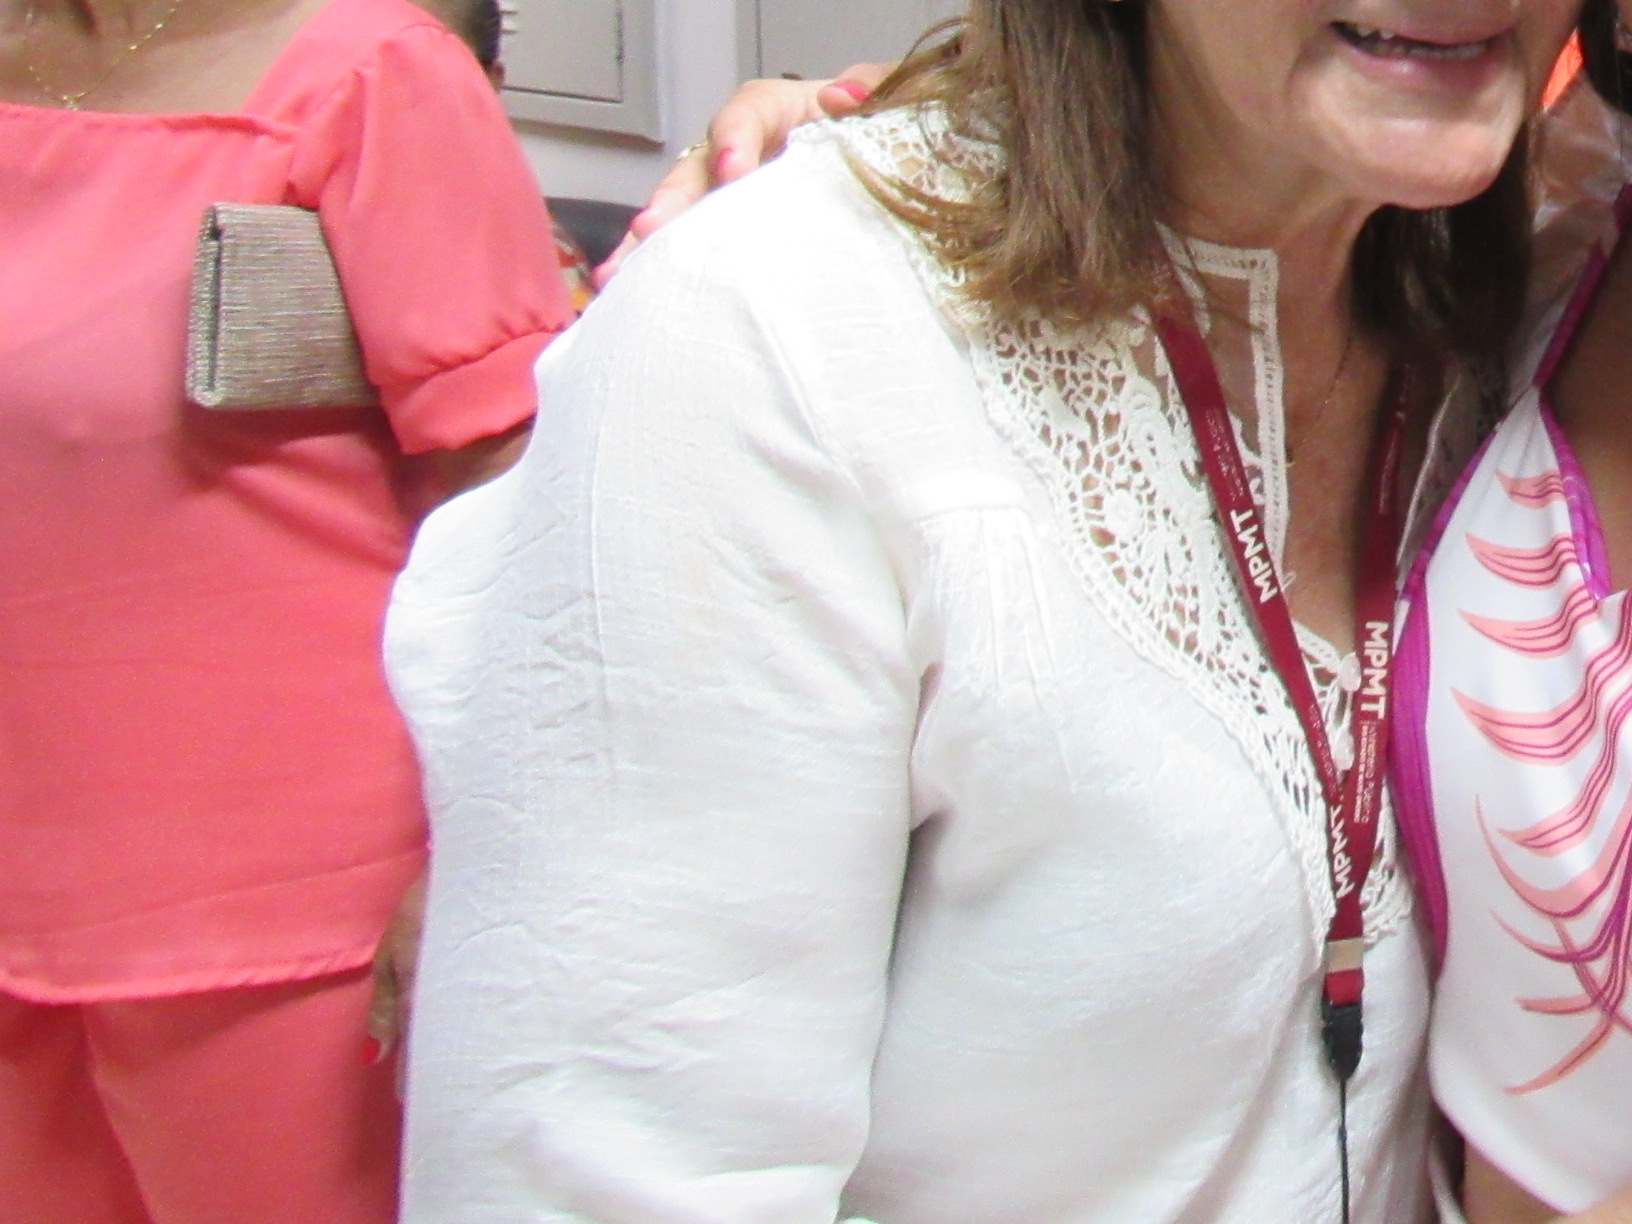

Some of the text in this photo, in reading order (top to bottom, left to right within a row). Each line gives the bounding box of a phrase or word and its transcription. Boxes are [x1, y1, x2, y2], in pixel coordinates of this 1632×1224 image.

[1229, 508, 1279, 604] MPMT
[1360, 620, 1390, 720] MPMT
[1329, 803, 1356, 899] MPMT
